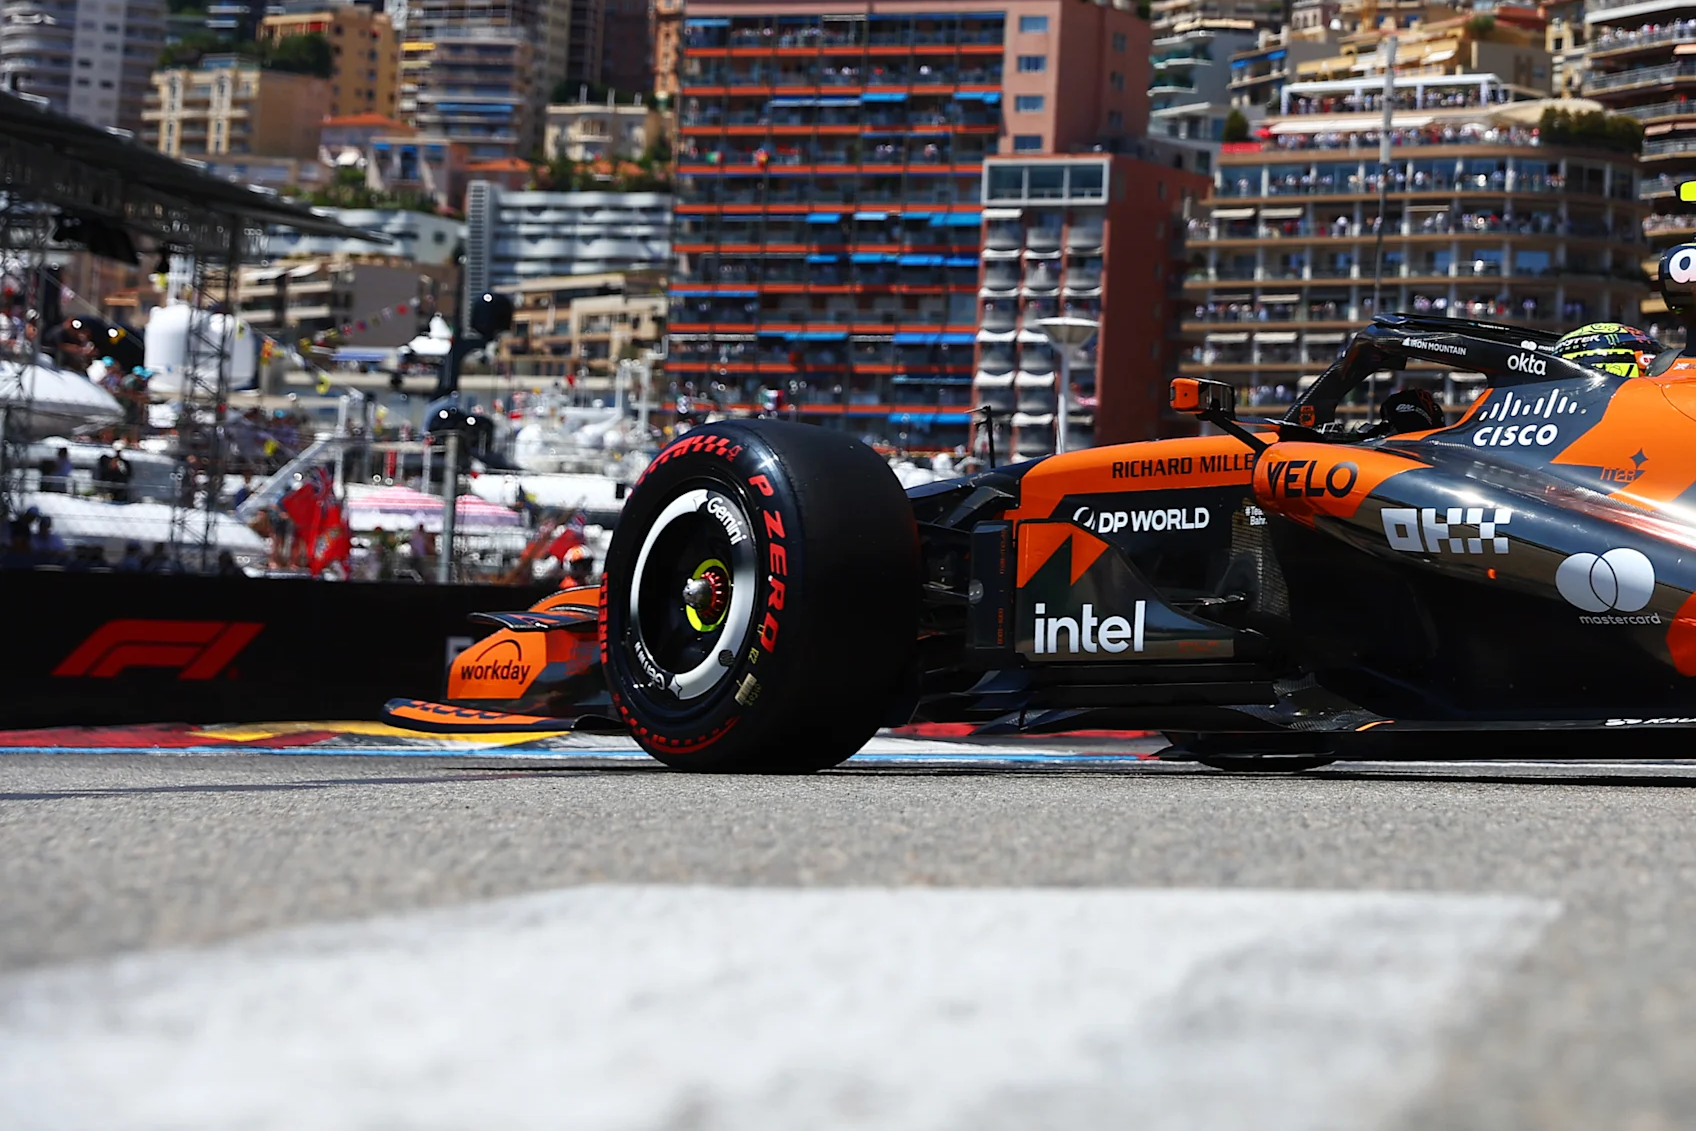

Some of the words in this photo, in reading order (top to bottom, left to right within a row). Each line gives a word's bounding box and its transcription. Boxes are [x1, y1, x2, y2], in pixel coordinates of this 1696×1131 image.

[1428, 342, 1467, 356] MOUNTAIN
[1507, 353, 1547, 376] okta
[1112, 457, 1193, 479] RICHARD
[1200, 453, 1253, 473] MILLE
[748, 474, 775, 498] P
[1266, 459, 1359, 500] VELO
[707, 495, 748, 547] Gemini
[1098, 512, 1129, 534] DP
[1130, 507, 1210, 532] WORLD
[760, 510, 788, 654] ZERO
[1033, 600, 1146, 655] intel
[1579, 611, 1662, 626] mastercard
[460, 660, 531, 686] workday
